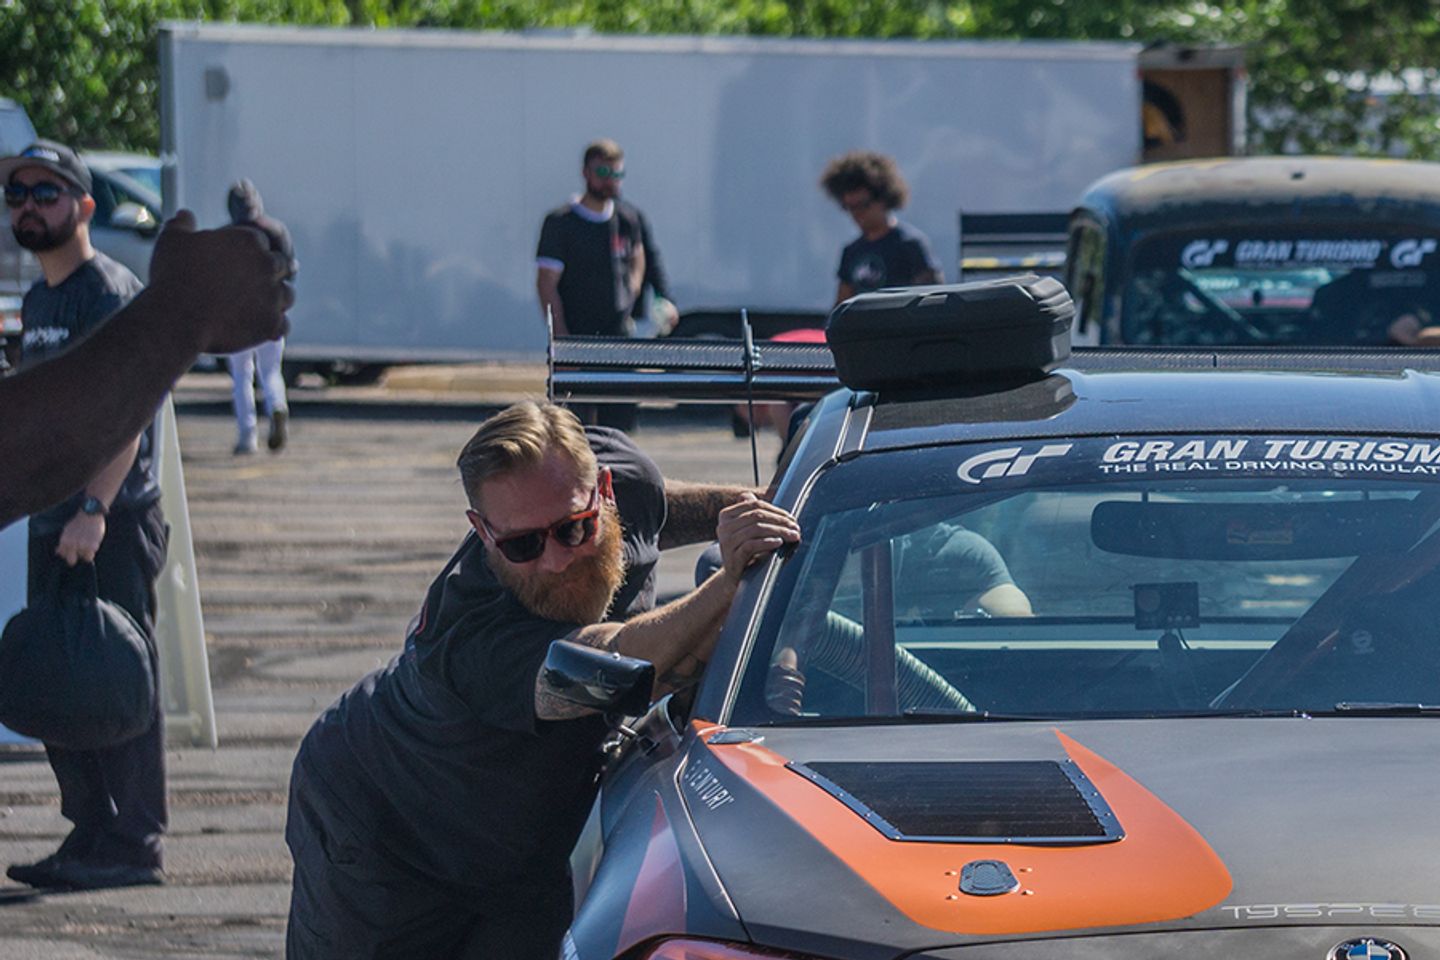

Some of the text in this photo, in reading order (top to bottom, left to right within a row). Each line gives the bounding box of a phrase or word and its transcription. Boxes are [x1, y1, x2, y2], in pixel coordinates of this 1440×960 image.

[1234, 240, 1290, 261] GRAN
[1295, 240, 1382, 261] TURISMO
[1102, 439, 1248, 463] GRAN
[1098, 463, 1147, 474] THE
[1154, 461, 1218, 472] REAL
[1225, 460, 1326, 471] DRIVING
